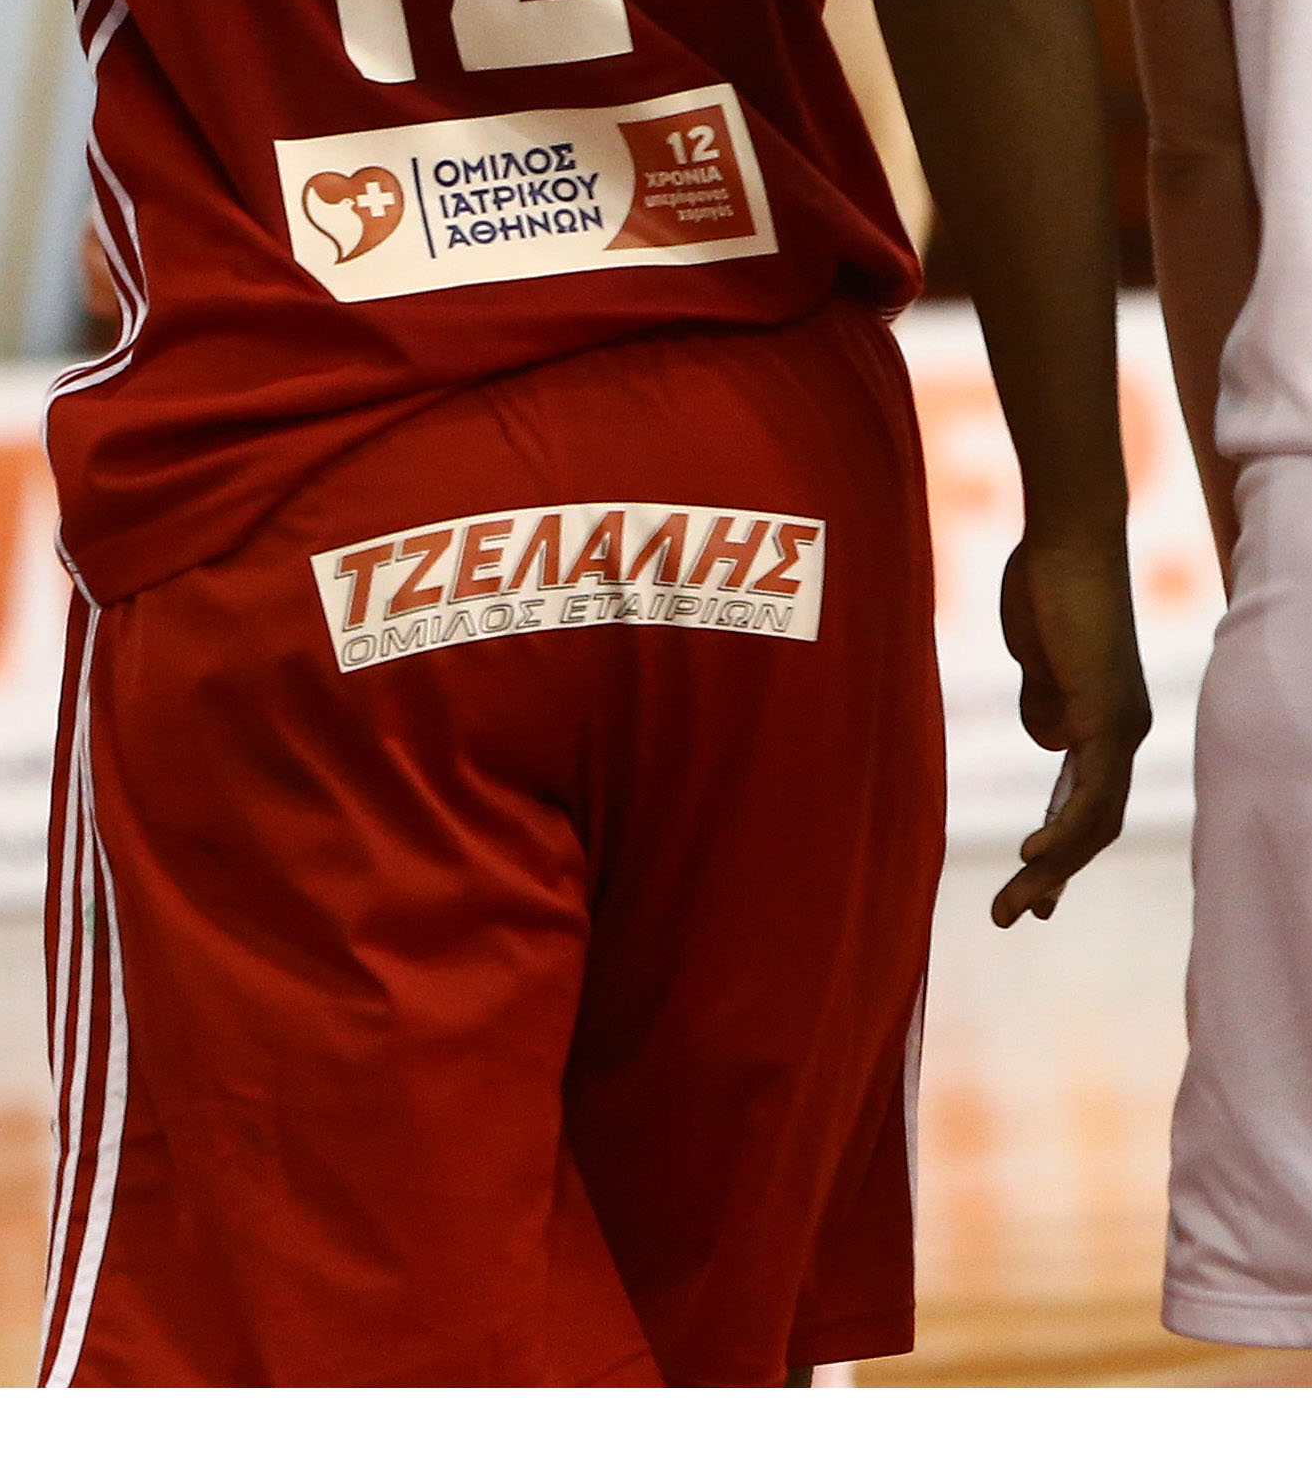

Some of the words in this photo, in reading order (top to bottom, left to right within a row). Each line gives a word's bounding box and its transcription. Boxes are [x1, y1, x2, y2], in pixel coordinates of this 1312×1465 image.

[433, 142, 577, 188] ΟΜΙΛΟΣ
[665, 124, 721, 165] 12
[439, 172, 602, 219] ΙΑΤΡΙΚΟΥ
[447, 205, 605, 250] ΑΘΗΝΩΝ
[340, 598, 546, 668] ΟΜΙΛΟΣ
